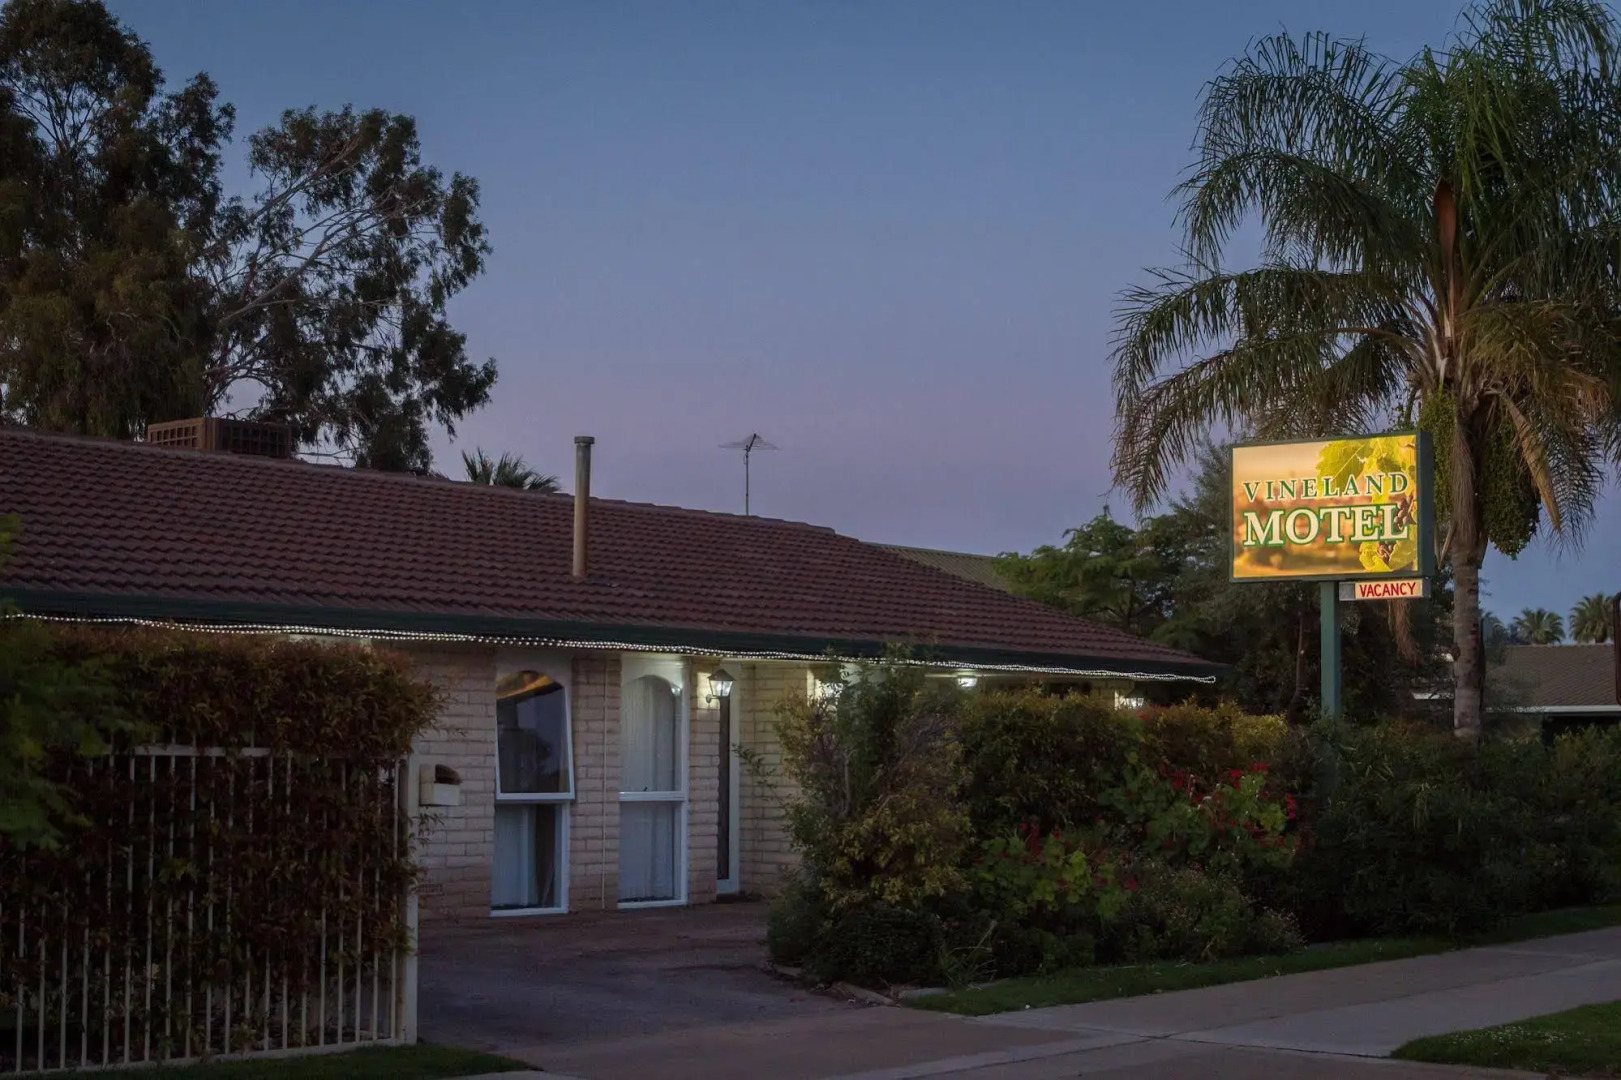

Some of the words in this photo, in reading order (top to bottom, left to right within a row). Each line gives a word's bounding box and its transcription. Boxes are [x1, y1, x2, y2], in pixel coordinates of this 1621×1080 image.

[1243, 473, 1409, 501] VINELAND
[1243, 504, 1409, 546] MOTEL
[1359, 582, 1416, 597] VACANCY
